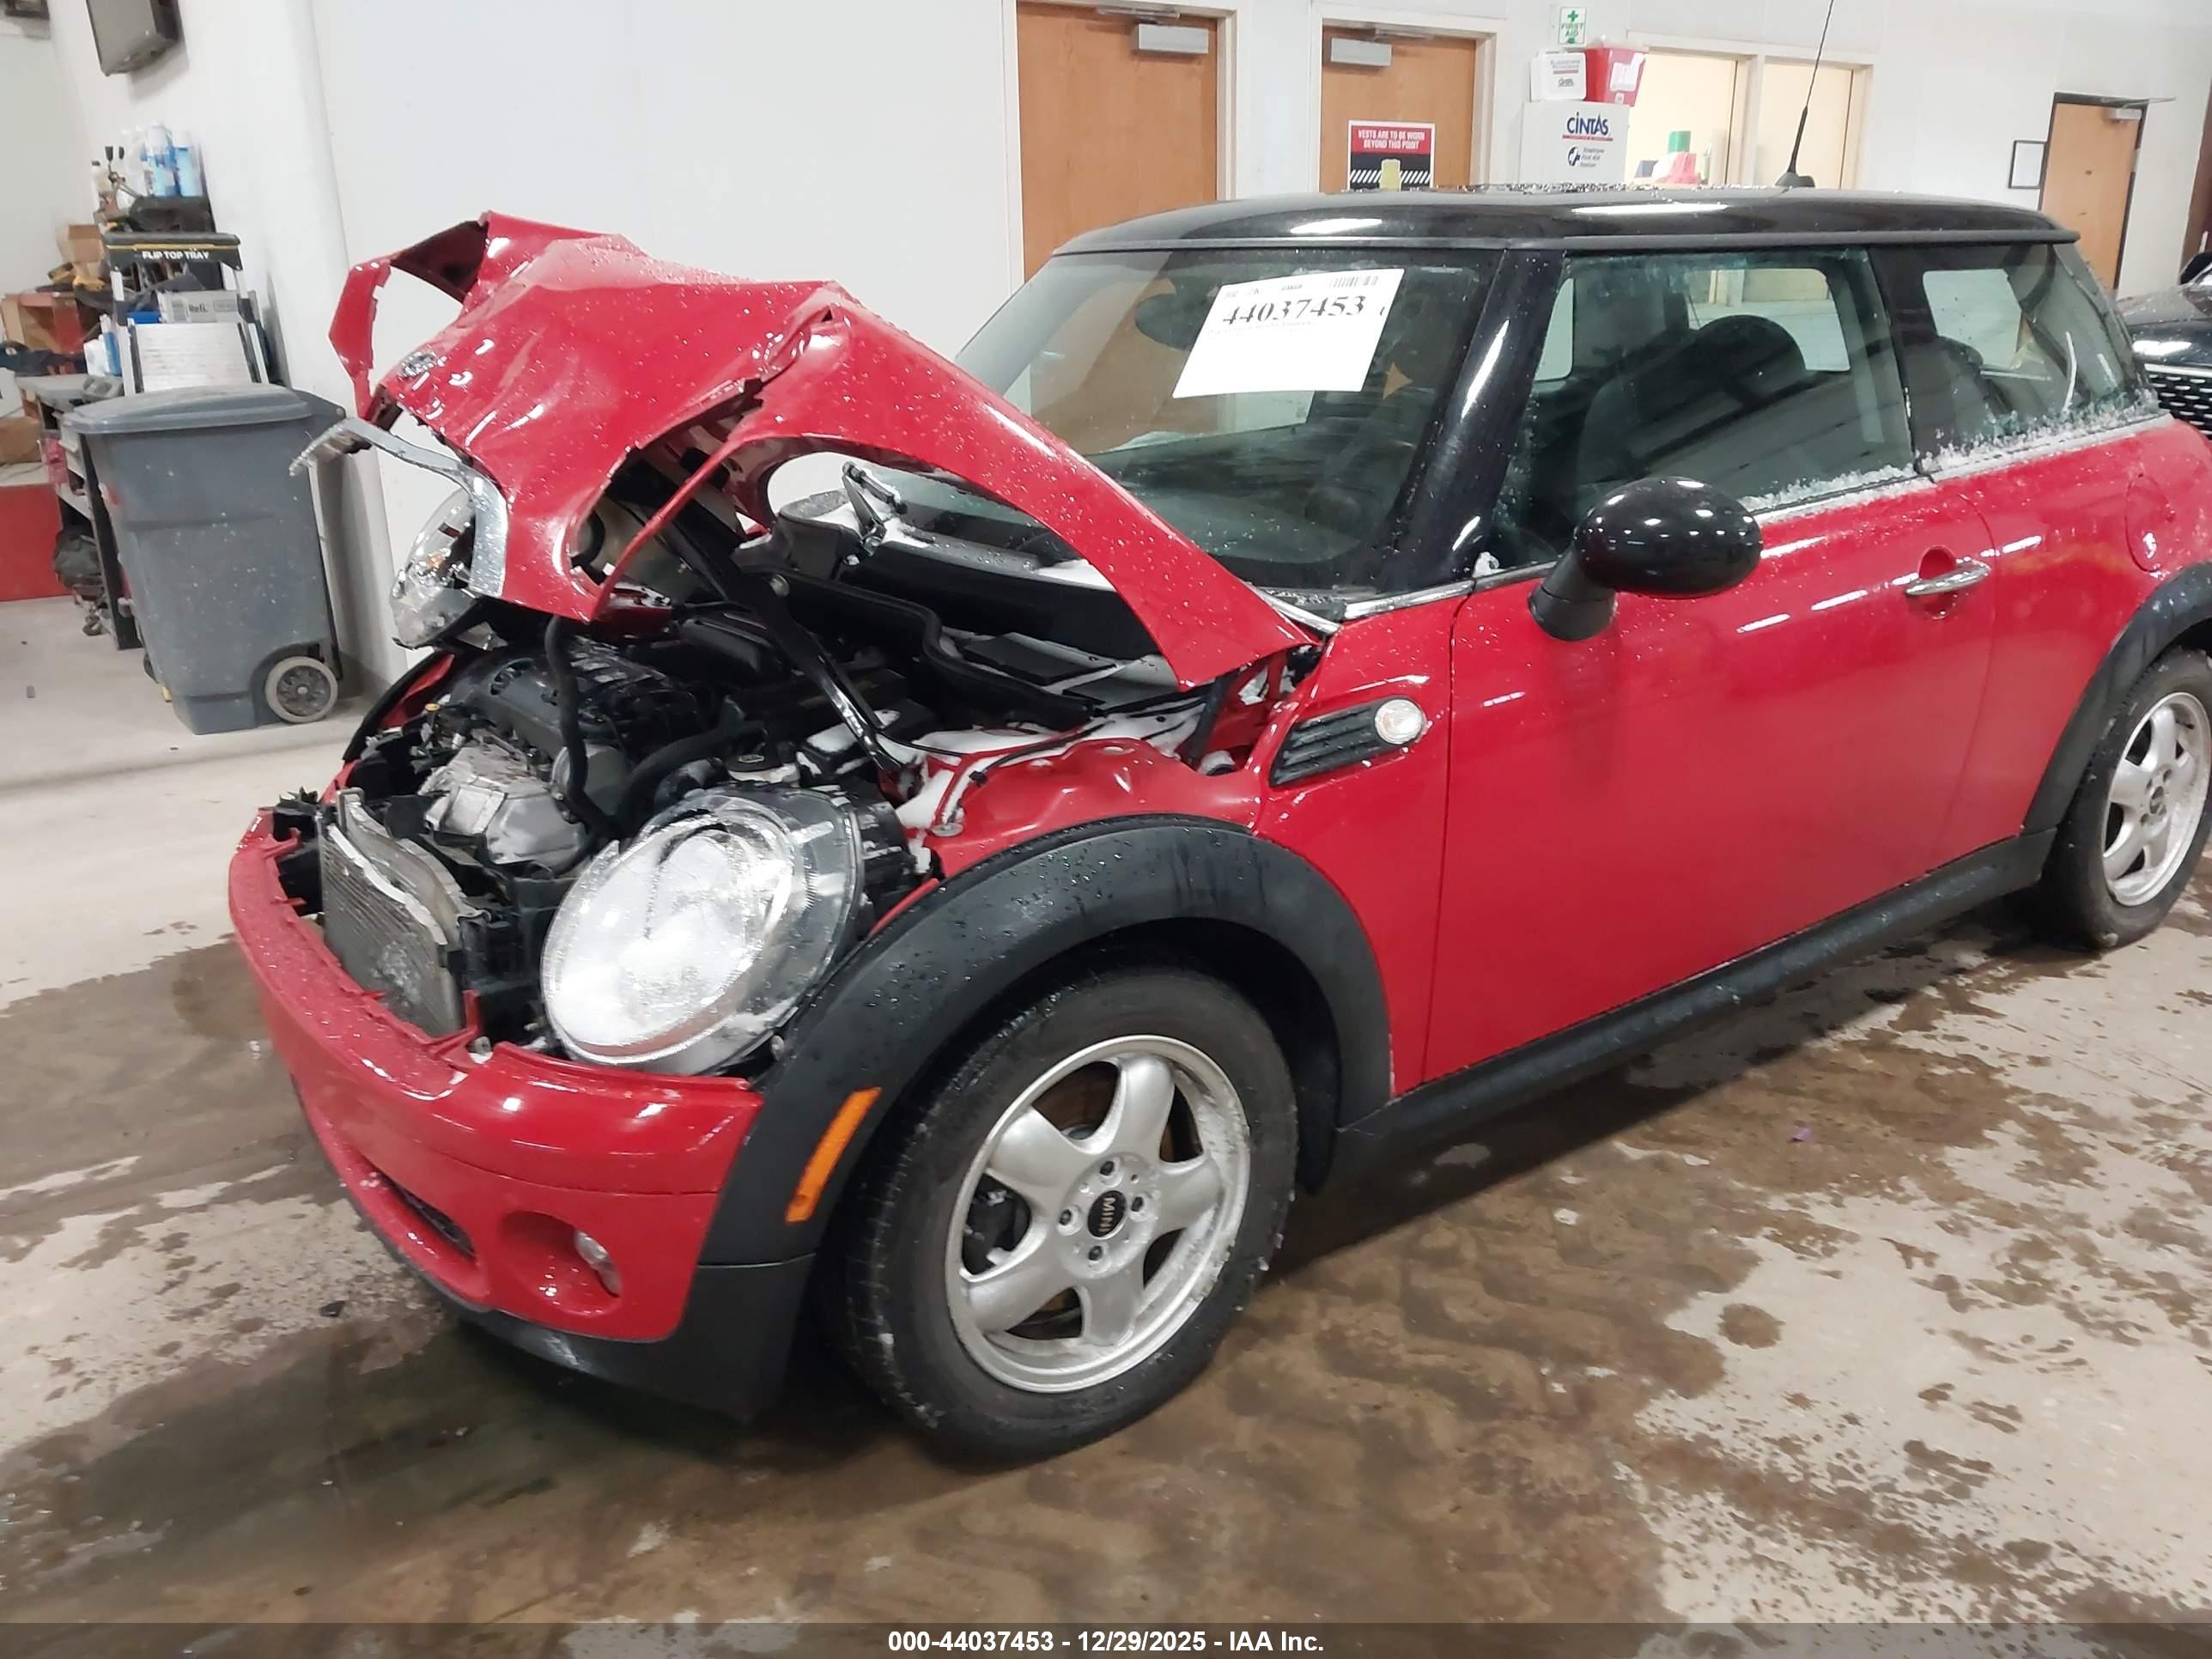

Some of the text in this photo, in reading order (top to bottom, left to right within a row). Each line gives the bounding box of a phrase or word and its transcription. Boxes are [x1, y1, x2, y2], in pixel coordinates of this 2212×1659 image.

[1358, 130, 1376, 138] VESTS
[1377, 130, 1389, 139] ARE
[1389, 131, 1398, 139] TO
[1407, 131, 1425, 140] WORN
[1364, 139, 1419, 149] BEYOND THIS POINT
[142, 250, 210, 259] FLIP TOP TRAY
[1222, 295, 1366, 325] 44037453
[1098, 1196, 1116, 1232] MINI
